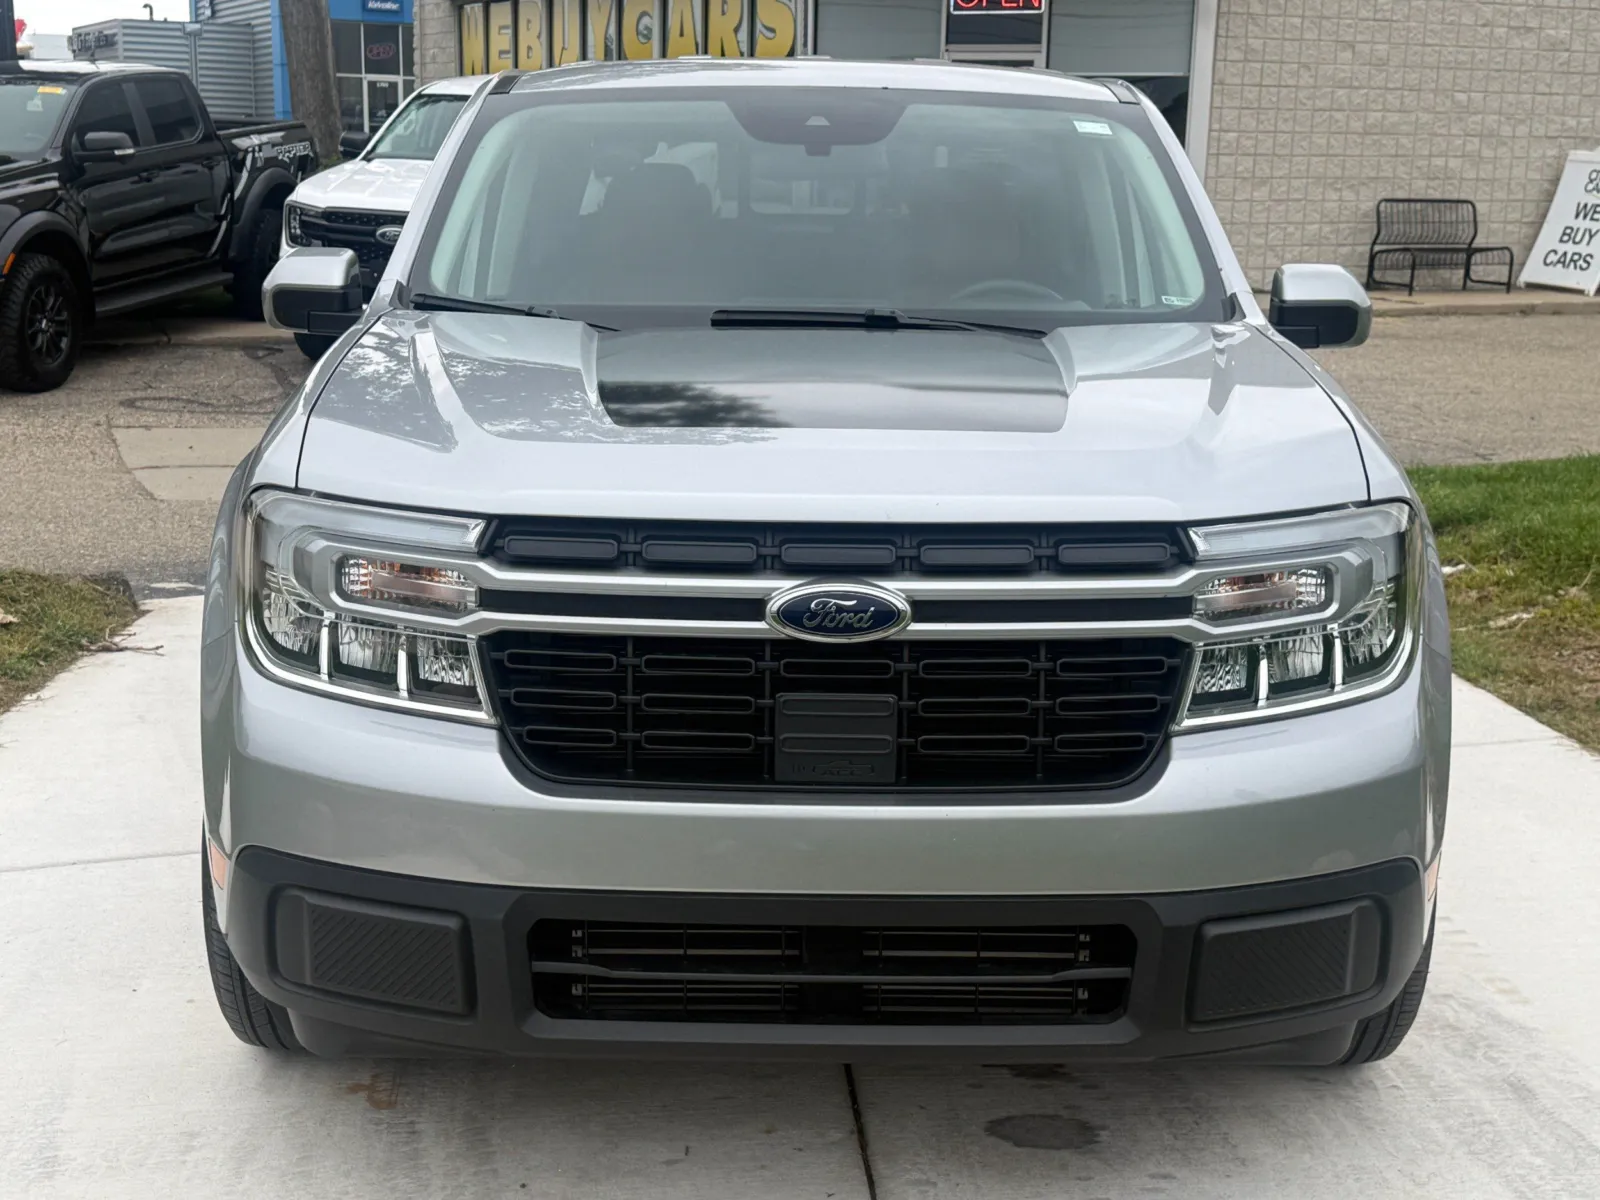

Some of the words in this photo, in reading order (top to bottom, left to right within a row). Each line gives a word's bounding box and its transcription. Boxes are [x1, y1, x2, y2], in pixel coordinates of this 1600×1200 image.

[275, 141, 315, 164] RAPTOR
[1574, 202, 1600, 222] WE
[1558, 226, 1600, 247] BUY
[1542, 249, 1594, 272] CARS
[803, 597, 875, 628] Ford
